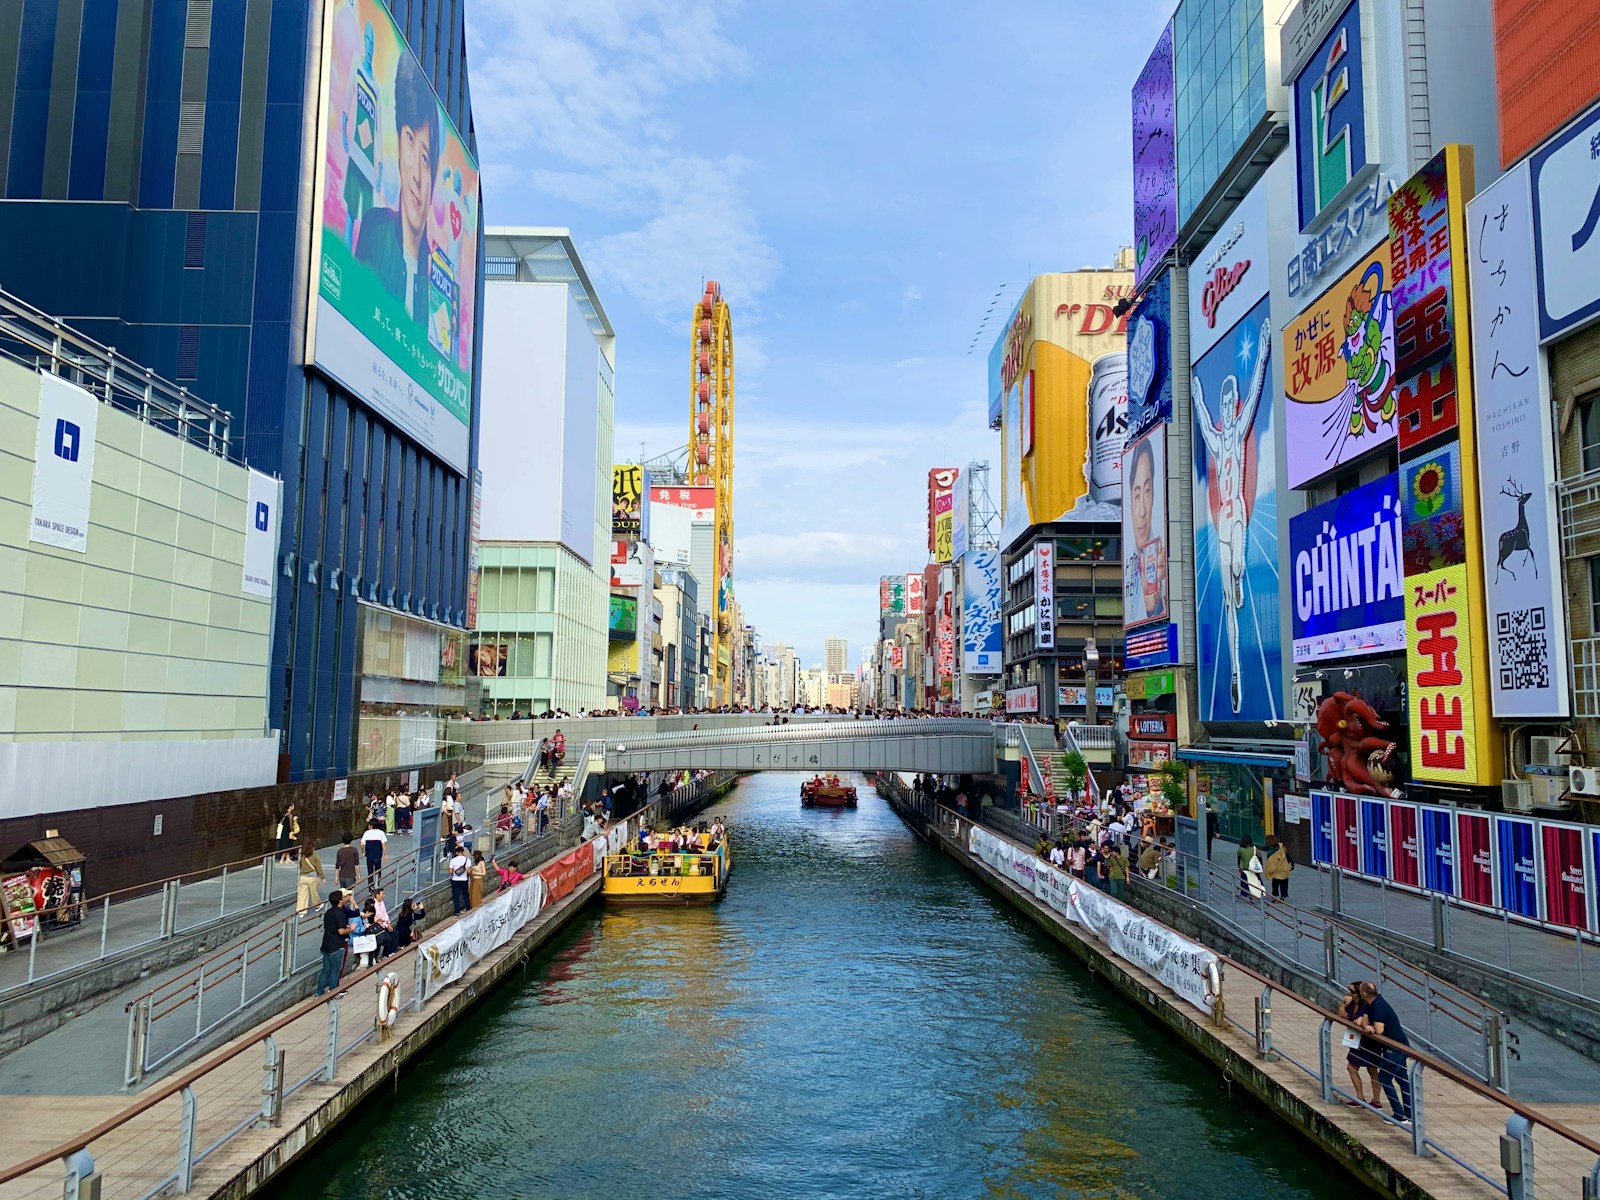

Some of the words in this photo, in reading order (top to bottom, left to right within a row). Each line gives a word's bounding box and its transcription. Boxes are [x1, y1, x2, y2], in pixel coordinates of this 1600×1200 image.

[1288, 172, 1398, 297] 日商エステム
[1202, 260, 1251, 328] Glico
[1295, 309, 1331, 352] かぜに
[1292, 329, 1336, 396] 改源
[1396, 285, 1458, 451] 玉出
[438, 360, 468, 411] サロンパス
[1486, 398, 1529, 421] HACHIKAN
[1492, 414, 1526, 433] YOSHINO
[1501, 441, 1520, 458] 吉野
[1224, 452, 1234, 519] グリコ
[34, 517, 51, 528] TAKARA
[52, 522, 64, 532] SPACE
[65, 525, 79, 536] DESIGN
[1296, 514, 1404, 622] CHINTAI
[1414, 579, 1457, 607] スーパー
[1040, 596, 1052, 644] かに道楽
[1416, 611, 1466, 769] 玉出
[1140, 721, 1164, 733] LOTTERIA
[756, 754, 818, 764] えびす橋
[1522, 856, 1533, 866] Street
[1562, 871, 1584, 884] Illuminated
[1570, 865, 1582, 876] Street
